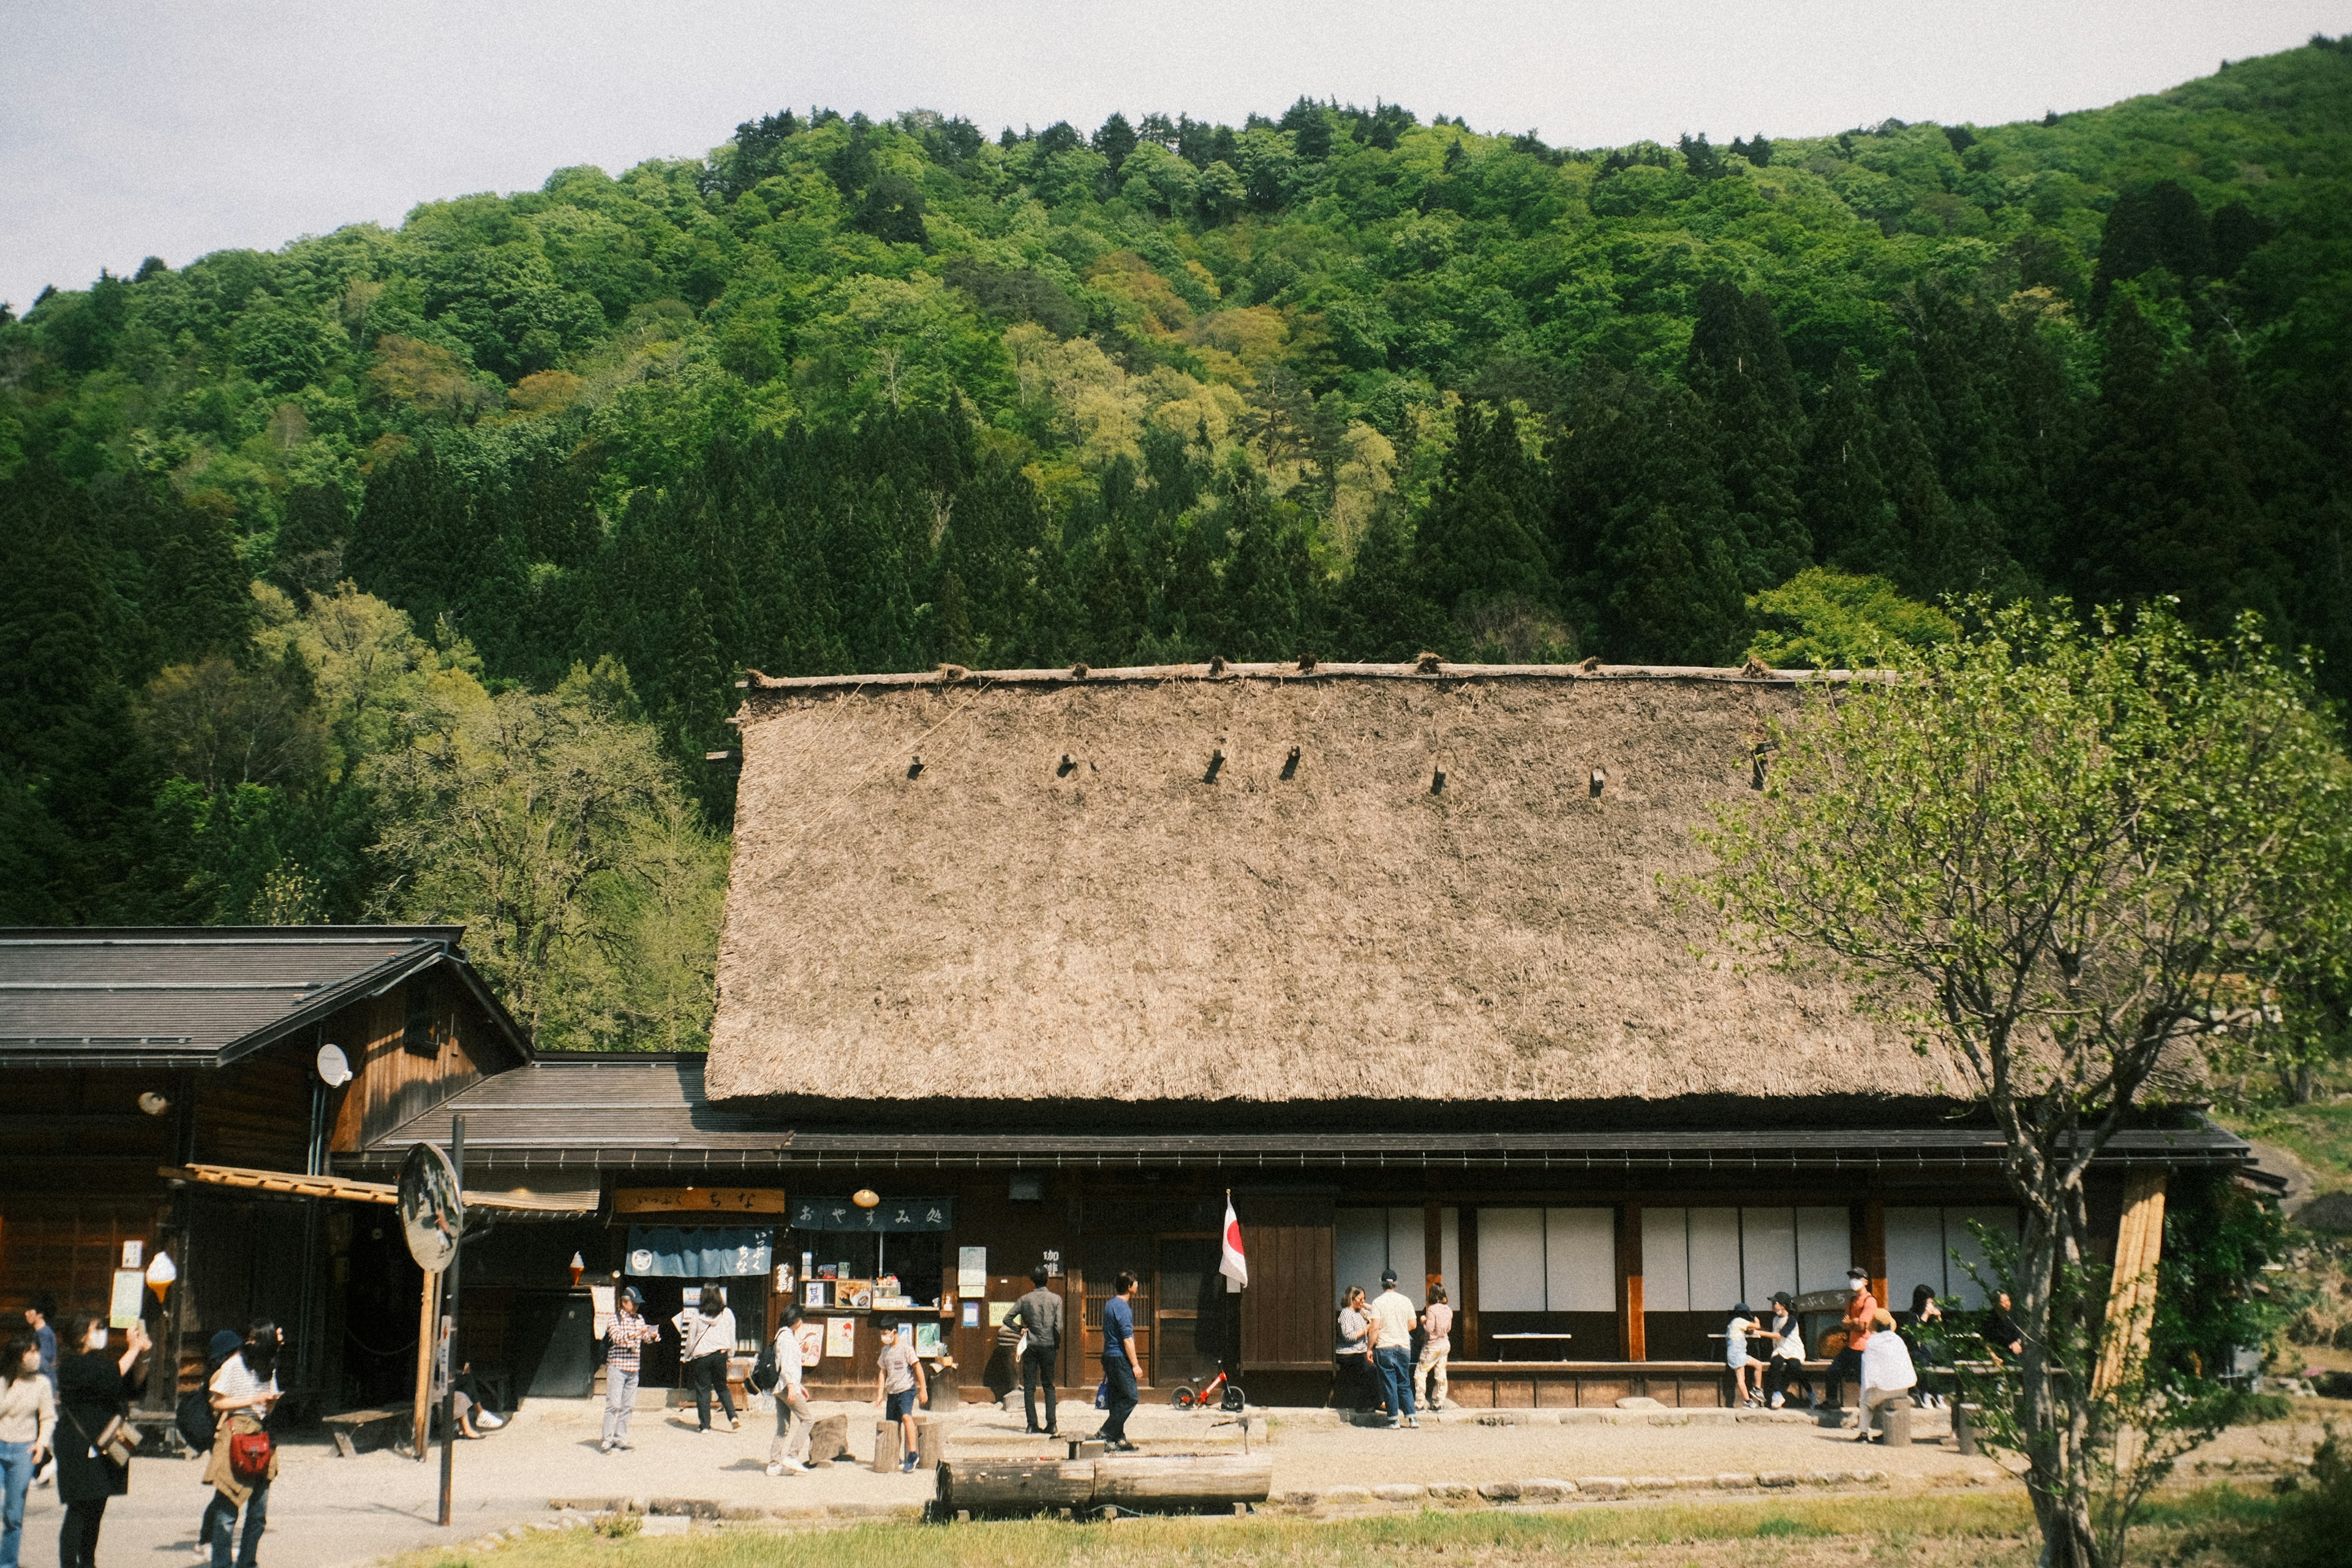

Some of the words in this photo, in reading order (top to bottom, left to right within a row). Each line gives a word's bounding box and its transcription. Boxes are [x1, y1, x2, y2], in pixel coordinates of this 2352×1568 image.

[709, 1192, 755, 1208] ちな
[800, 1205, 943, 1226] おやすみ処
[736, 1245, 748, 1273] ちな
[1043, 1250, 1059, 1275] 珈琲
